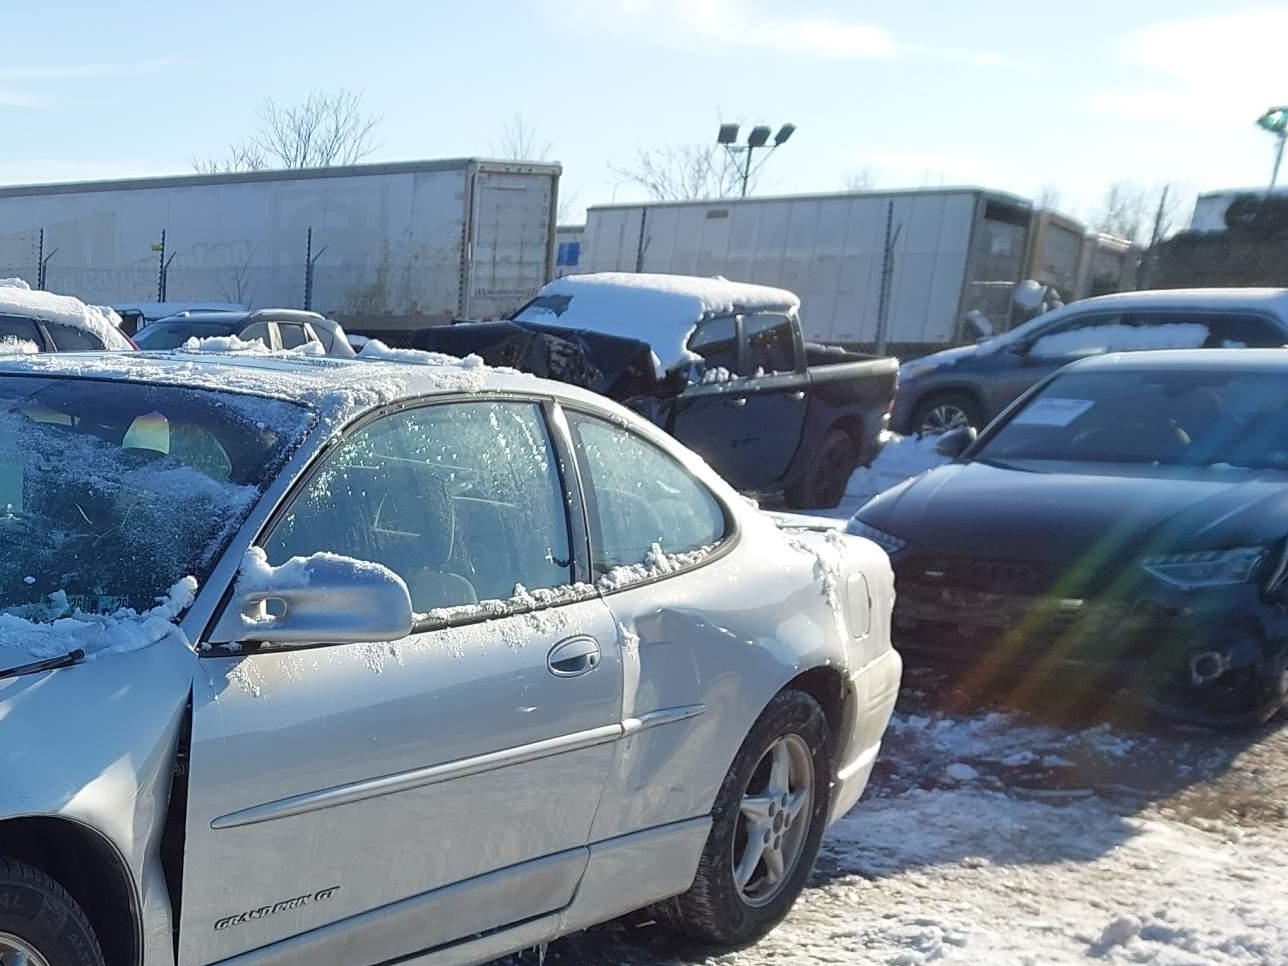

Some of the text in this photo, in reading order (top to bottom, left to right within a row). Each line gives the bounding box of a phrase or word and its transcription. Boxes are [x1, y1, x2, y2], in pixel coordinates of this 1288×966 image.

[214, 885, 341, 931] GRAND PRIX GT
